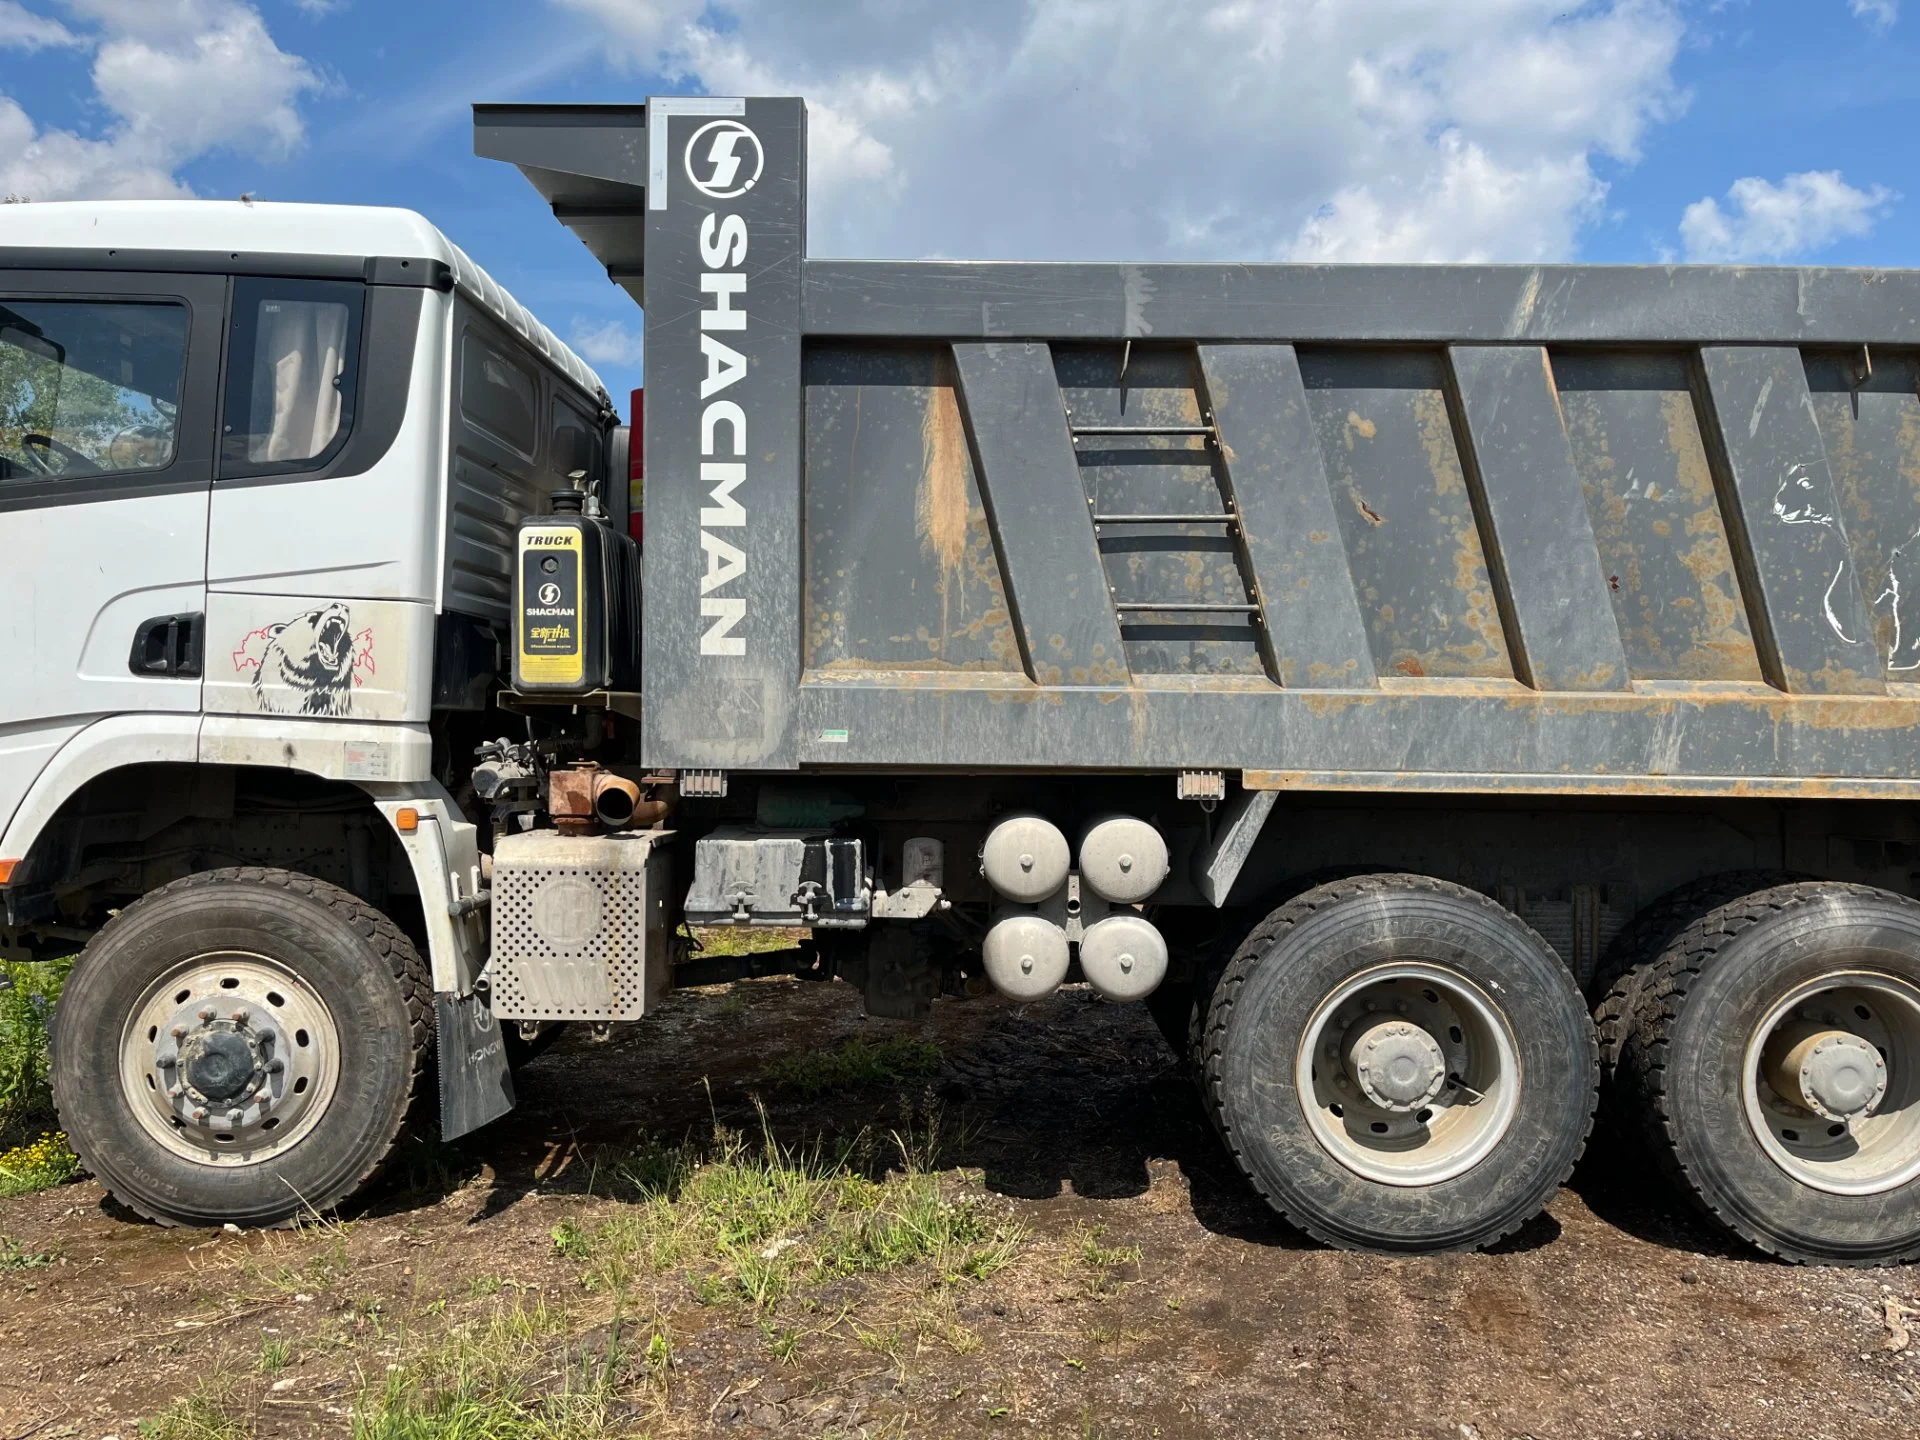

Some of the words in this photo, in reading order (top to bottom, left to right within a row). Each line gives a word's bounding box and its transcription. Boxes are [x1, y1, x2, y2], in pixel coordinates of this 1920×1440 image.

[699, 212, 748, 656] SHACMAN
[526, 536, 573, 545] TRUCK
[526, 608, 574, 616] SHACMAN
